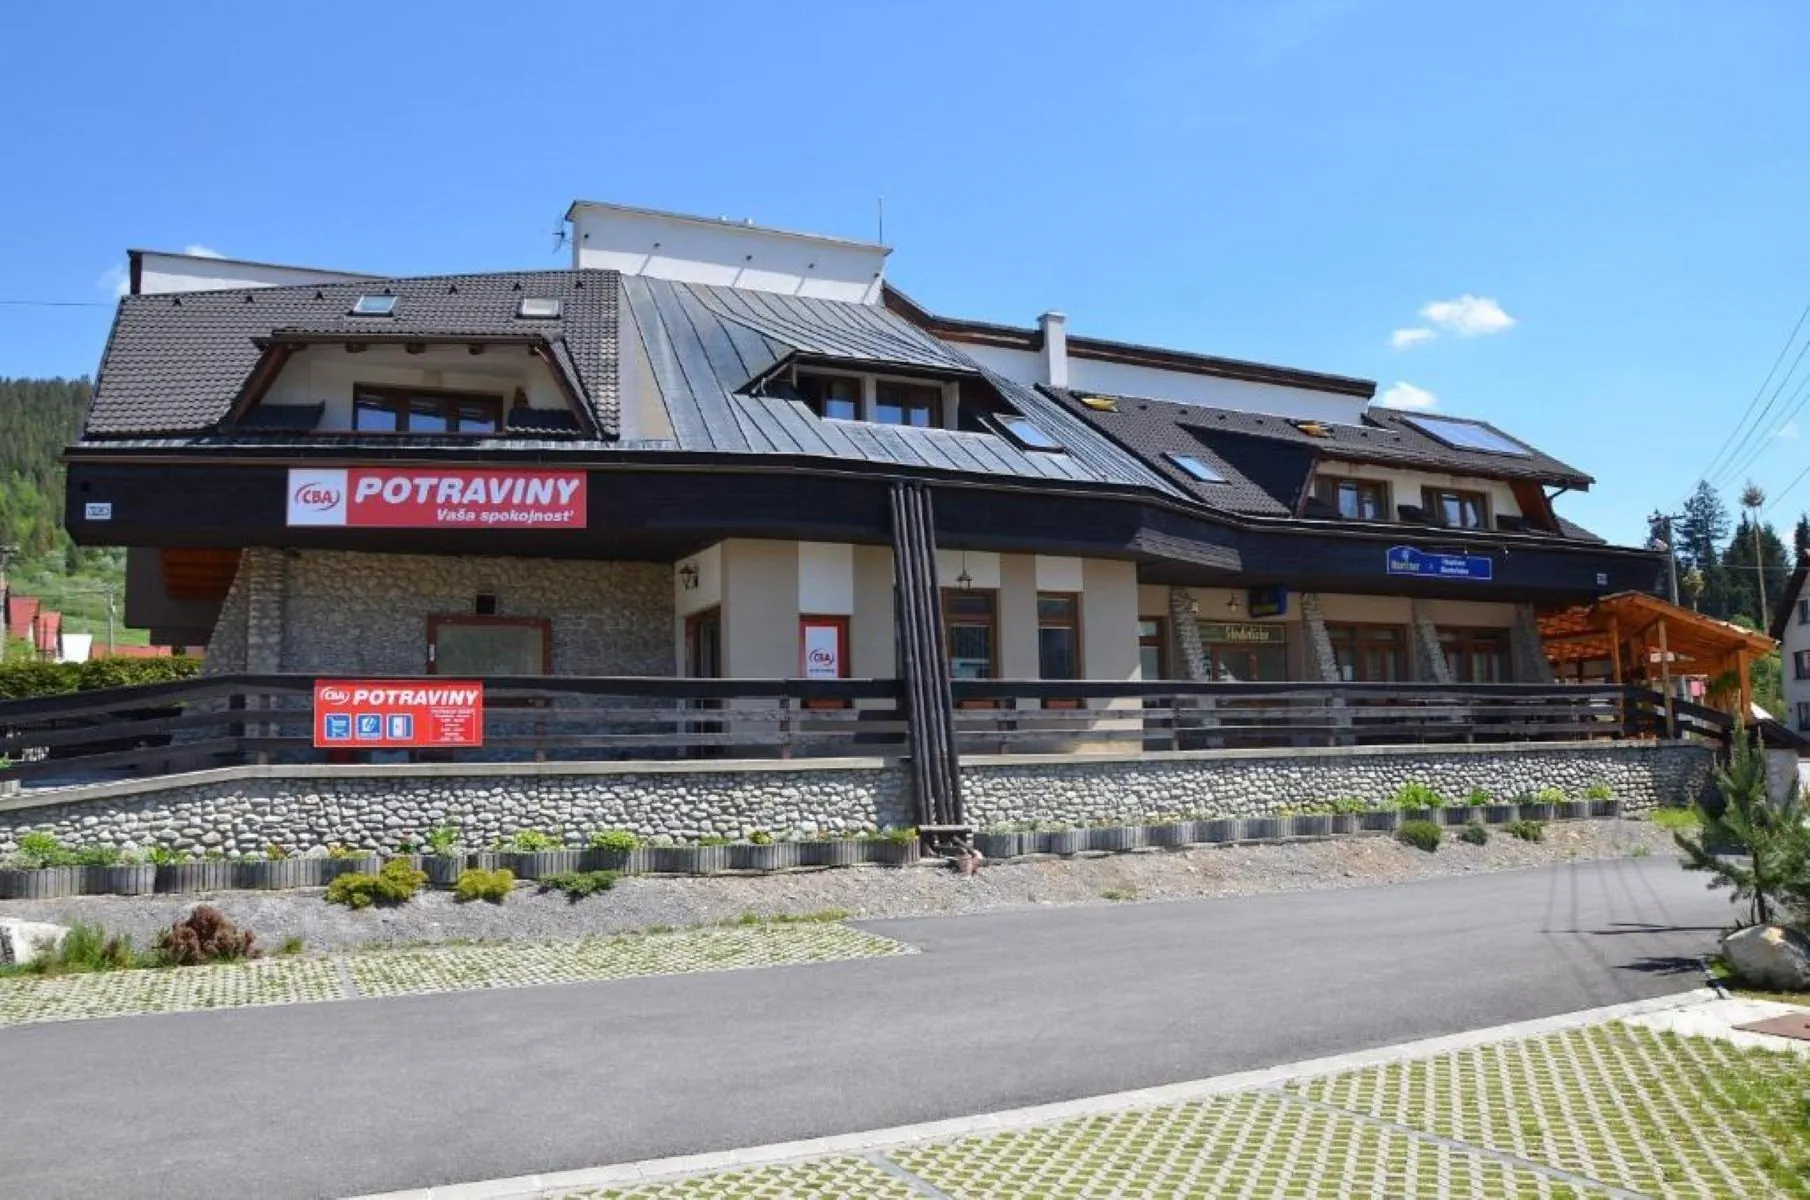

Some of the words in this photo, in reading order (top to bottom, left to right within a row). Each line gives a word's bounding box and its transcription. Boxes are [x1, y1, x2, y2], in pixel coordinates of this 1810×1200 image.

[300, 487, 335, 505] CBA
[355, 476, 580, 505] POTRAVINY
[436, 508, 475, 522] Vaša
[353, 689, 478, 705] POTRAVINY
